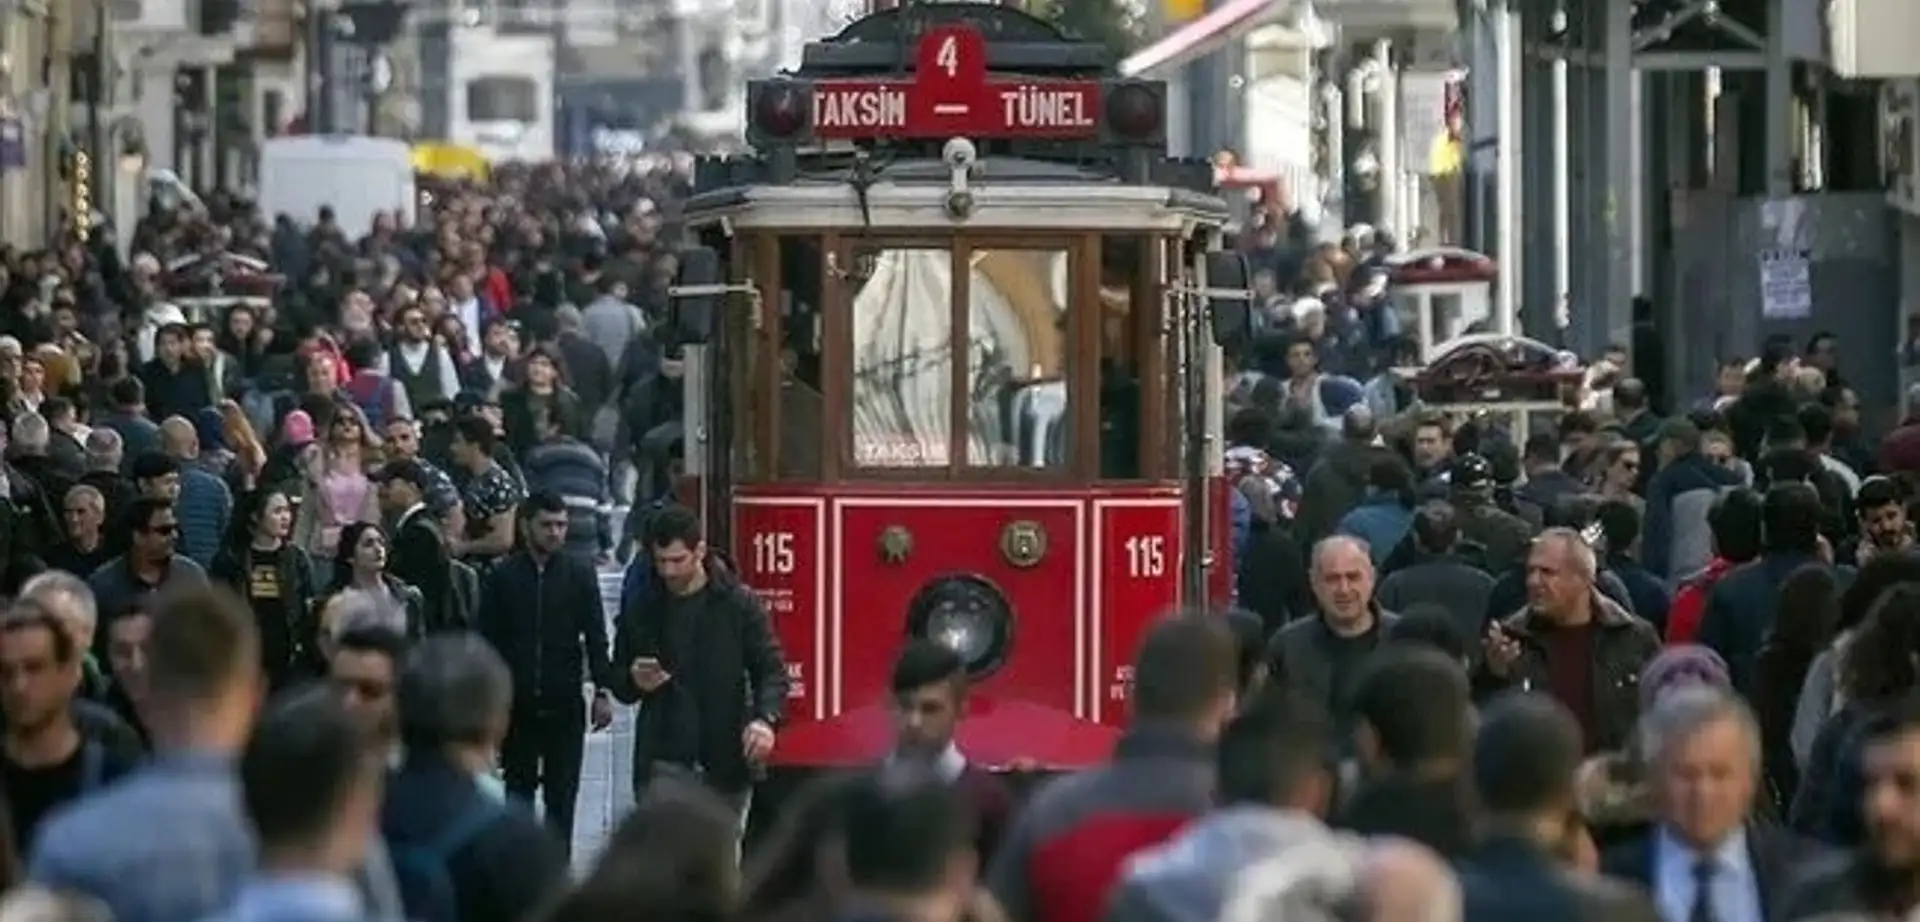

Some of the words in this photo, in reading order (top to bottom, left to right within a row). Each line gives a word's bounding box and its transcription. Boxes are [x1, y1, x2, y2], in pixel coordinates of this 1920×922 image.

[936, 35, 959, 77] 4
[812, 85, 906, 127] TAKSİM
[1001, 85, 1094, 127] TÜNEL
[753, 532, 794, 573] 115
[1125, 535, 1164, 578] 115
